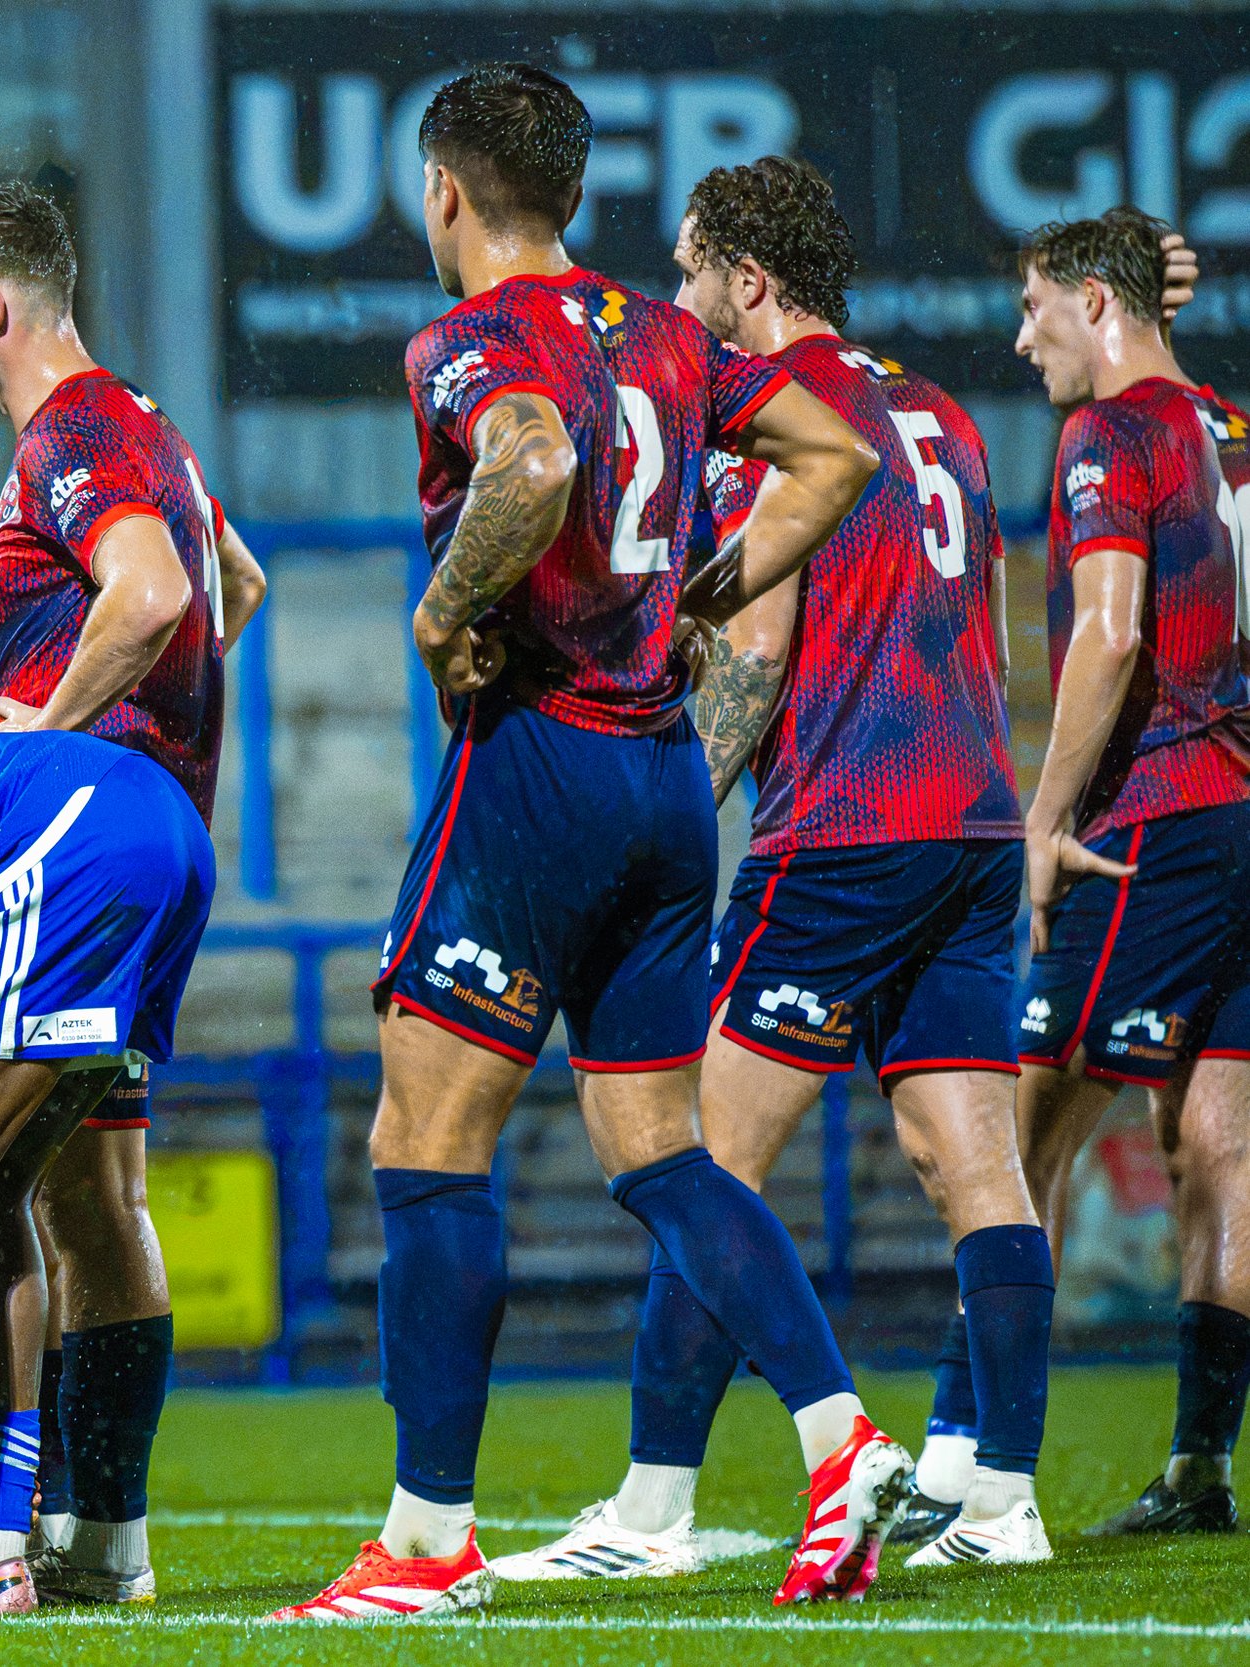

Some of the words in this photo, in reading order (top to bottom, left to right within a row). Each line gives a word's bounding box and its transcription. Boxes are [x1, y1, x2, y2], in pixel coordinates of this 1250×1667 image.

[50, 467, 92, 514] ttis
[610, 383, 671, 575] 2
[887, 410, 967, 580] 5
[425, 968, 455, 990] SEP
[61, 1019, 92, 1028] AZTEK
[751, 1012, 779, 1031] SEP
